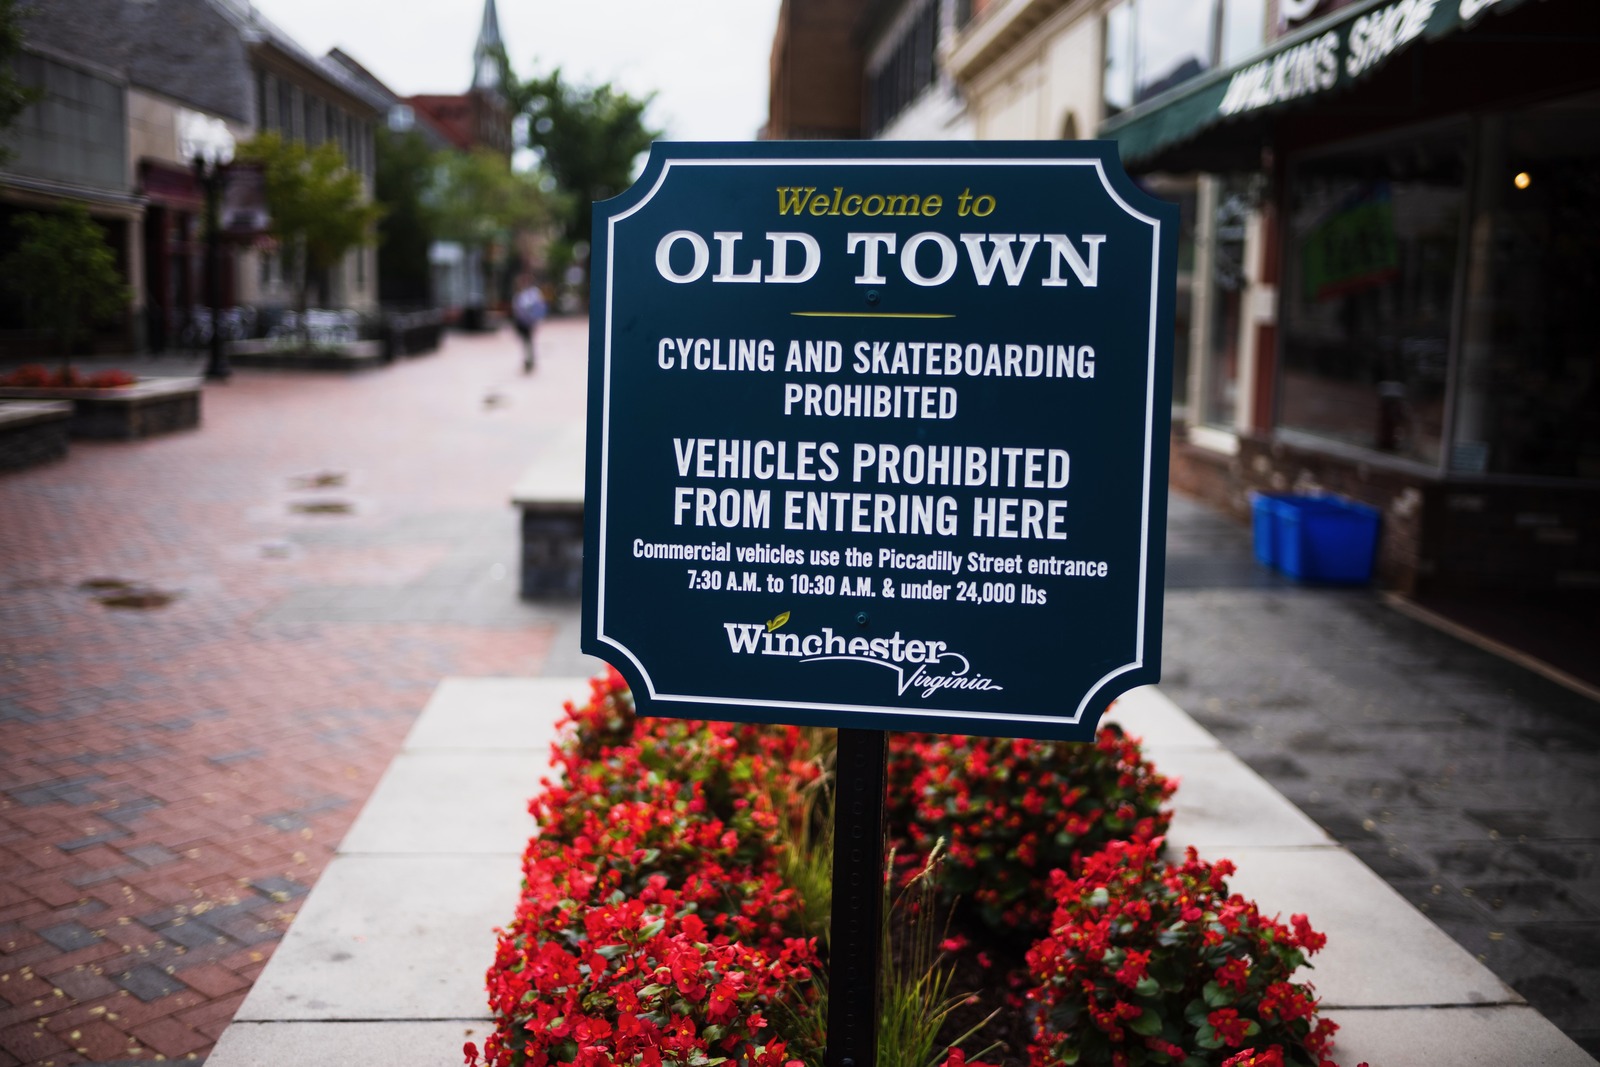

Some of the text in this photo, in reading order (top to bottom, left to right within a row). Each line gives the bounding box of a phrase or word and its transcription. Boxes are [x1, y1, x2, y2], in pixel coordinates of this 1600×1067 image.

[776, 186, 996, 217] Welcome to
[655, 229, 1107, 288] OLD TOWN
[658, 337, 1095, 379] CYCLING AND SKATEBOARDING
[784, 383, 958, 420] PROHIBITED
[673, 437, 1070, 489] VEHICLES PROHIBITED
[674, 486, 1068, 540] FROM ENTERING HERE
[633, 538, 1108, 578] Commercial vehicles use the Piccadilly Street entrance
[687, 569, 1047, 605] 7:30 A.M. to 10:30 A.M. & under 24,000 lbs
[723, 621, 948, 664] Winchester
[898, 663, 1003, 698] Virginia
